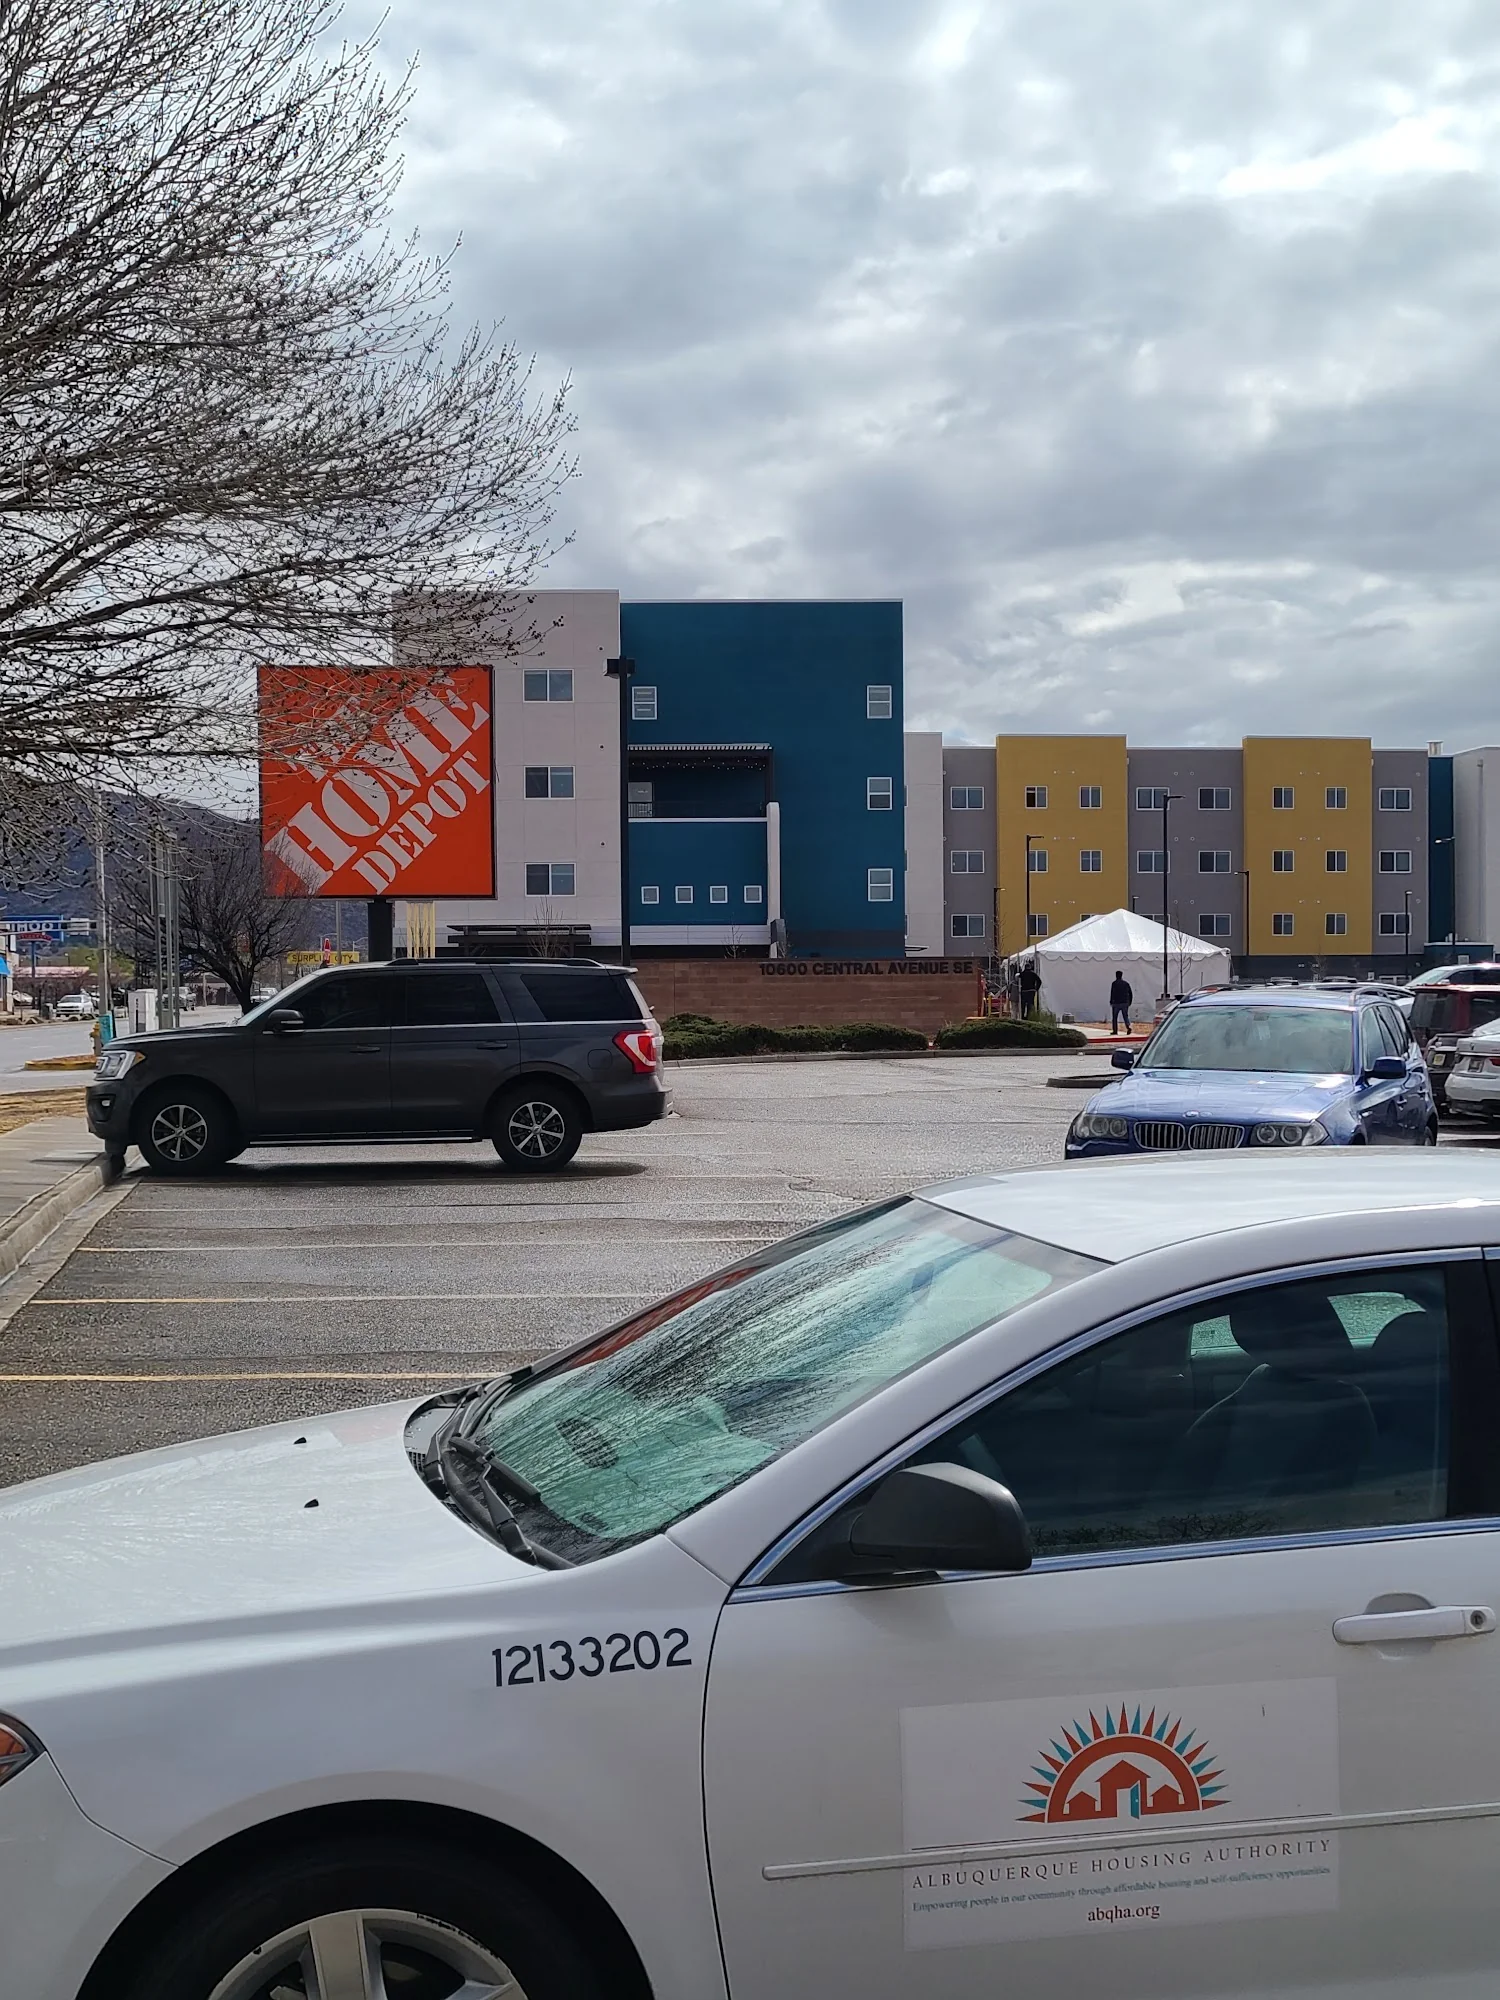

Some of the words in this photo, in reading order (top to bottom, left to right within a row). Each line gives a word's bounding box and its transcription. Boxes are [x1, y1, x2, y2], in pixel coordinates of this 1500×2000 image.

[264, 669, 490, 895] HOME
[352, 751, 490, 895] DEPOT
[291, 953, 332, 963] SURPL
[334, 953, 354, 962] CTY
[759, 962, 808, 976] 10600
[812, 961, 883, 976] CENTRAL
[887, 961, 949, 975] AVENUE
[952, 961, 973, 975] SE
[492, 1627, 692, 1687] 12133202
[912, 1861, 1079, 1889] ALBUQUERQUE
[1091, 1851, 1192, 1873] HOUSING
[1203, 1839, 1331, 1863] AUTHORITY
[912, 1899, 968, 1913] Empowering
[969, 1895, 1000, 1909] people
[1001, 1895, 1010, 1903] in
[1011, 1893, 1026, 1902] our
[1028, 1889, 1076, 1901] community
[1078, 1885, 1112, 1898] through
[1113, 1881, 1156, 1893] affordable
[1158, 1878, 1192, 1890] housing
[1193, 1876, 1209, 1885] and
[1210, 1871, 1274, 1884] self-sufficiency
[1276, 1866, 1331, 1880] opportunities
[1088, 1904, 1160, 1924] abqha.org
